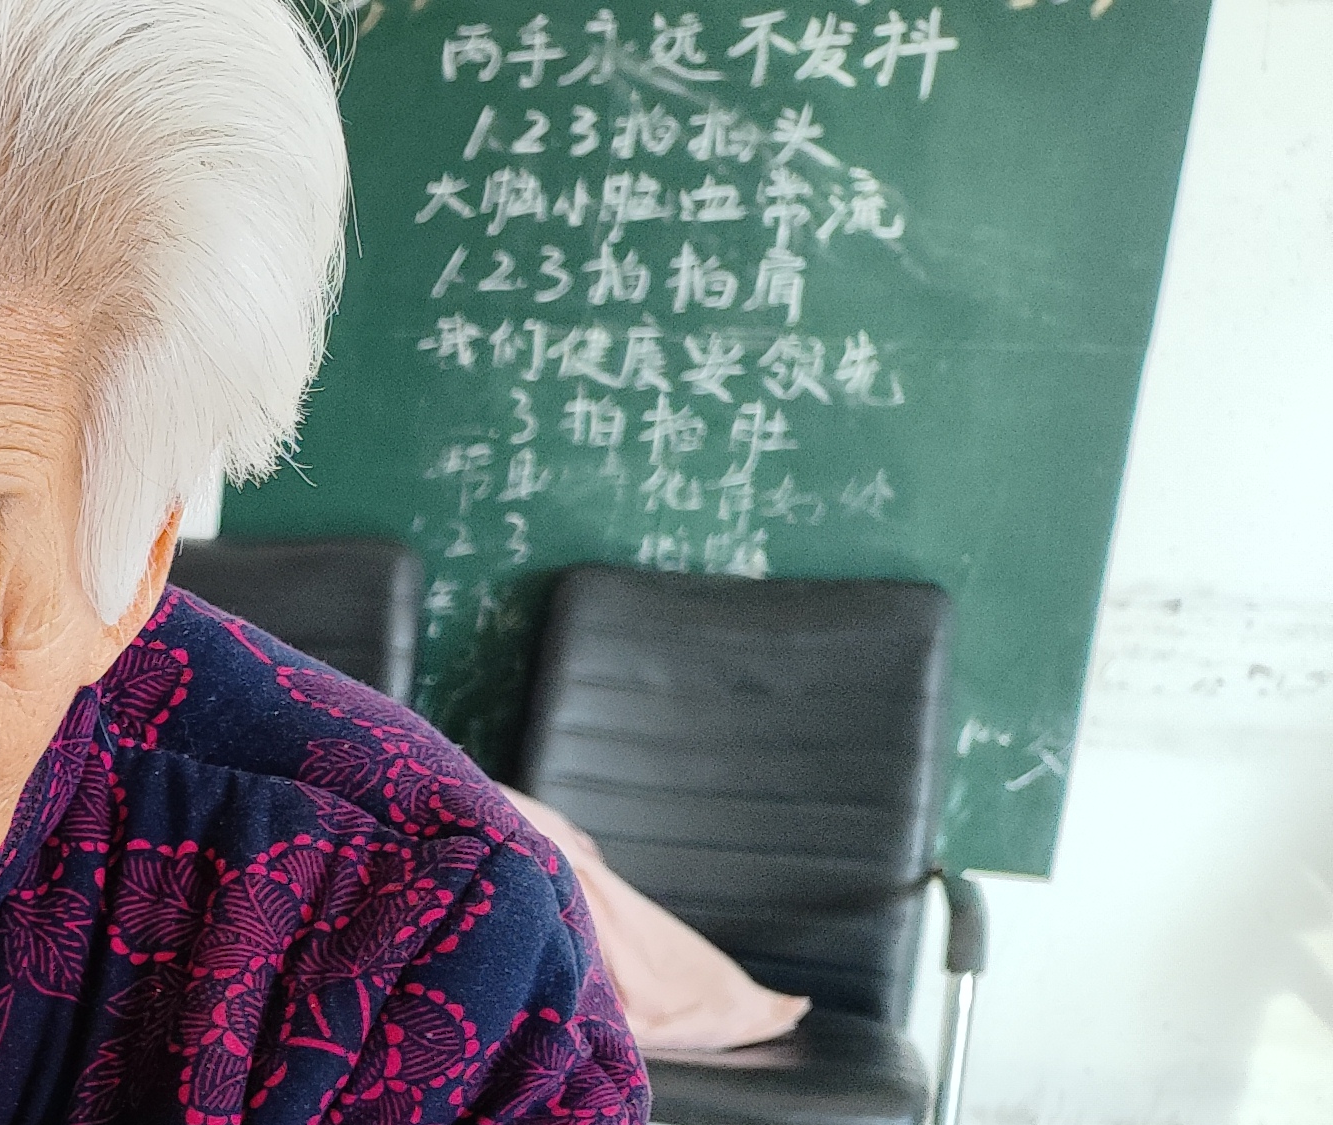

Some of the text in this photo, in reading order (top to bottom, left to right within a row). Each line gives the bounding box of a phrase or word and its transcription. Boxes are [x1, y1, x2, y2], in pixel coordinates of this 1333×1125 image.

[440, 7, 960, 99] 两手永远不发抖
